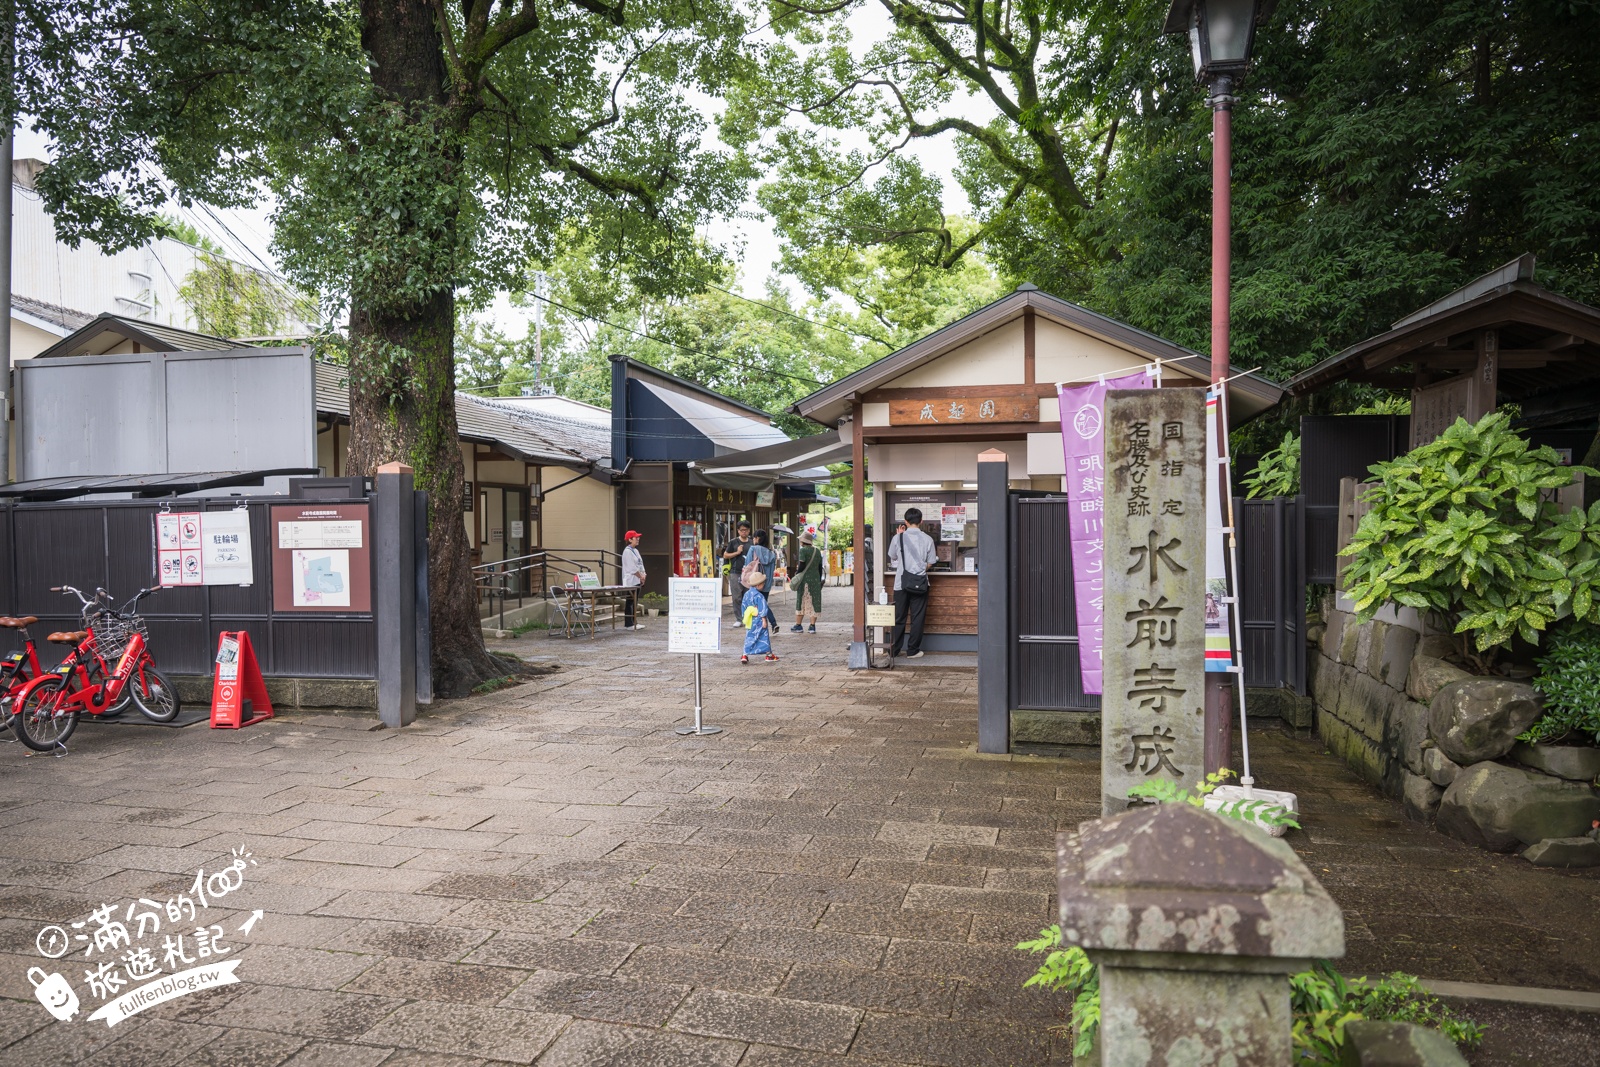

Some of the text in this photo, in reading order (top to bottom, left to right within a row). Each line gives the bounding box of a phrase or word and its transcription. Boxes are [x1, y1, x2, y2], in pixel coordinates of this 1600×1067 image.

[706, 488, 744, 505] みはらし
[1126, 421, 1151, 517] 名勝及び史跡
[1161, 421, 1185, 517] 国指定
[213, 534, 239, 544] 駐輪場
